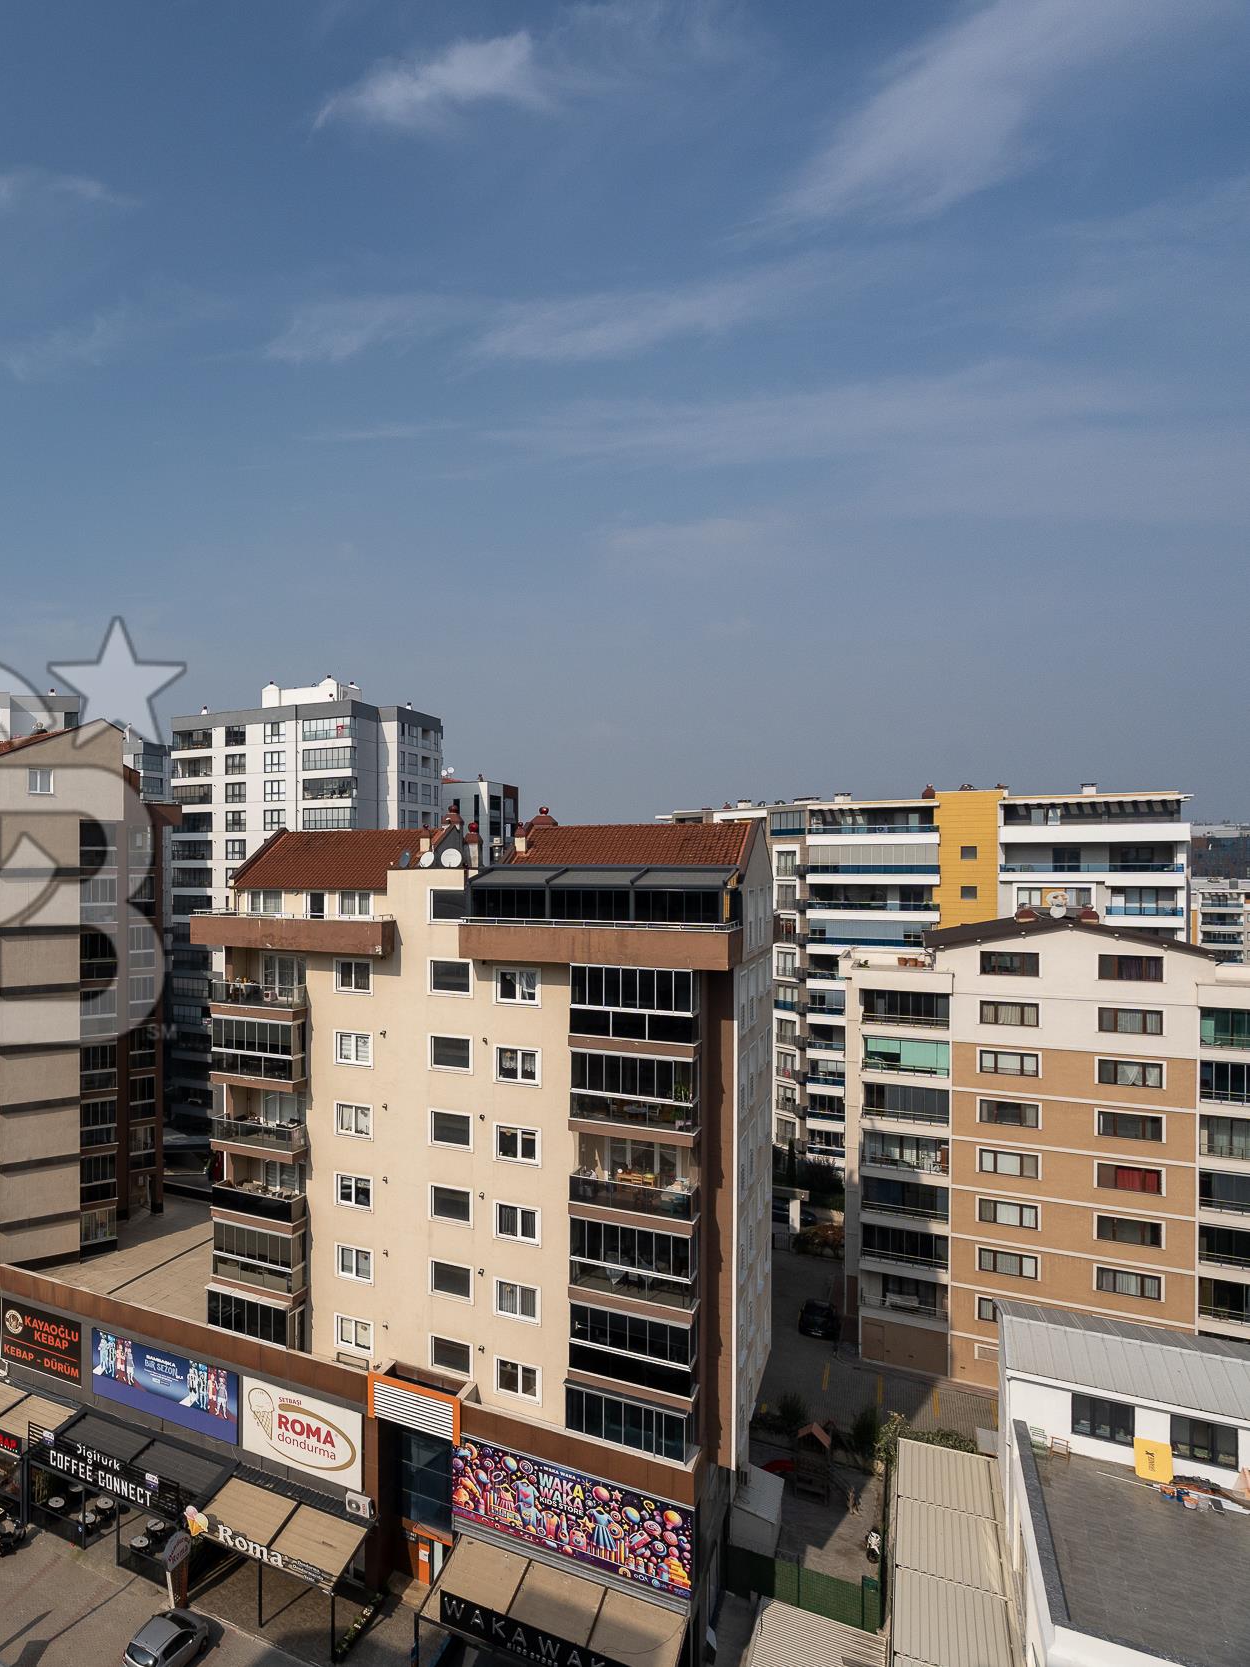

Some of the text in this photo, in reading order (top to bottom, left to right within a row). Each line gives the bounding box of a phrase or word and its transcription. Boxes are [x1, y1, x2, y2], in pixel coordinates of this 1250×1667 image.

[24, 1314, 79, 1342] KAYAOĞLU
[34, 1327, 69, 1351] KEBAP
[3, 1343, 35, 1362] KEBAP
[43, 1356, 79, 1379] DÜRÜM
[278, 1396, 302, 1406] SETBAŞI
[277, 1413, 336, 1448] ROMA
[277, 1432, 336, 1461] dondurma
[50, 1450, 93, 1482] COFFEE
[98, 1470, 152, 1507] CONNECT
[538, 1472, 584, 1500] WAKA
[539, 1485, 583, 1510] WAKA
[539, 1496, 584, 1516] KIDS STORE
[217, 1524, 284, 1568] Roma
[444, 1596, 527, 1647] WAKA
